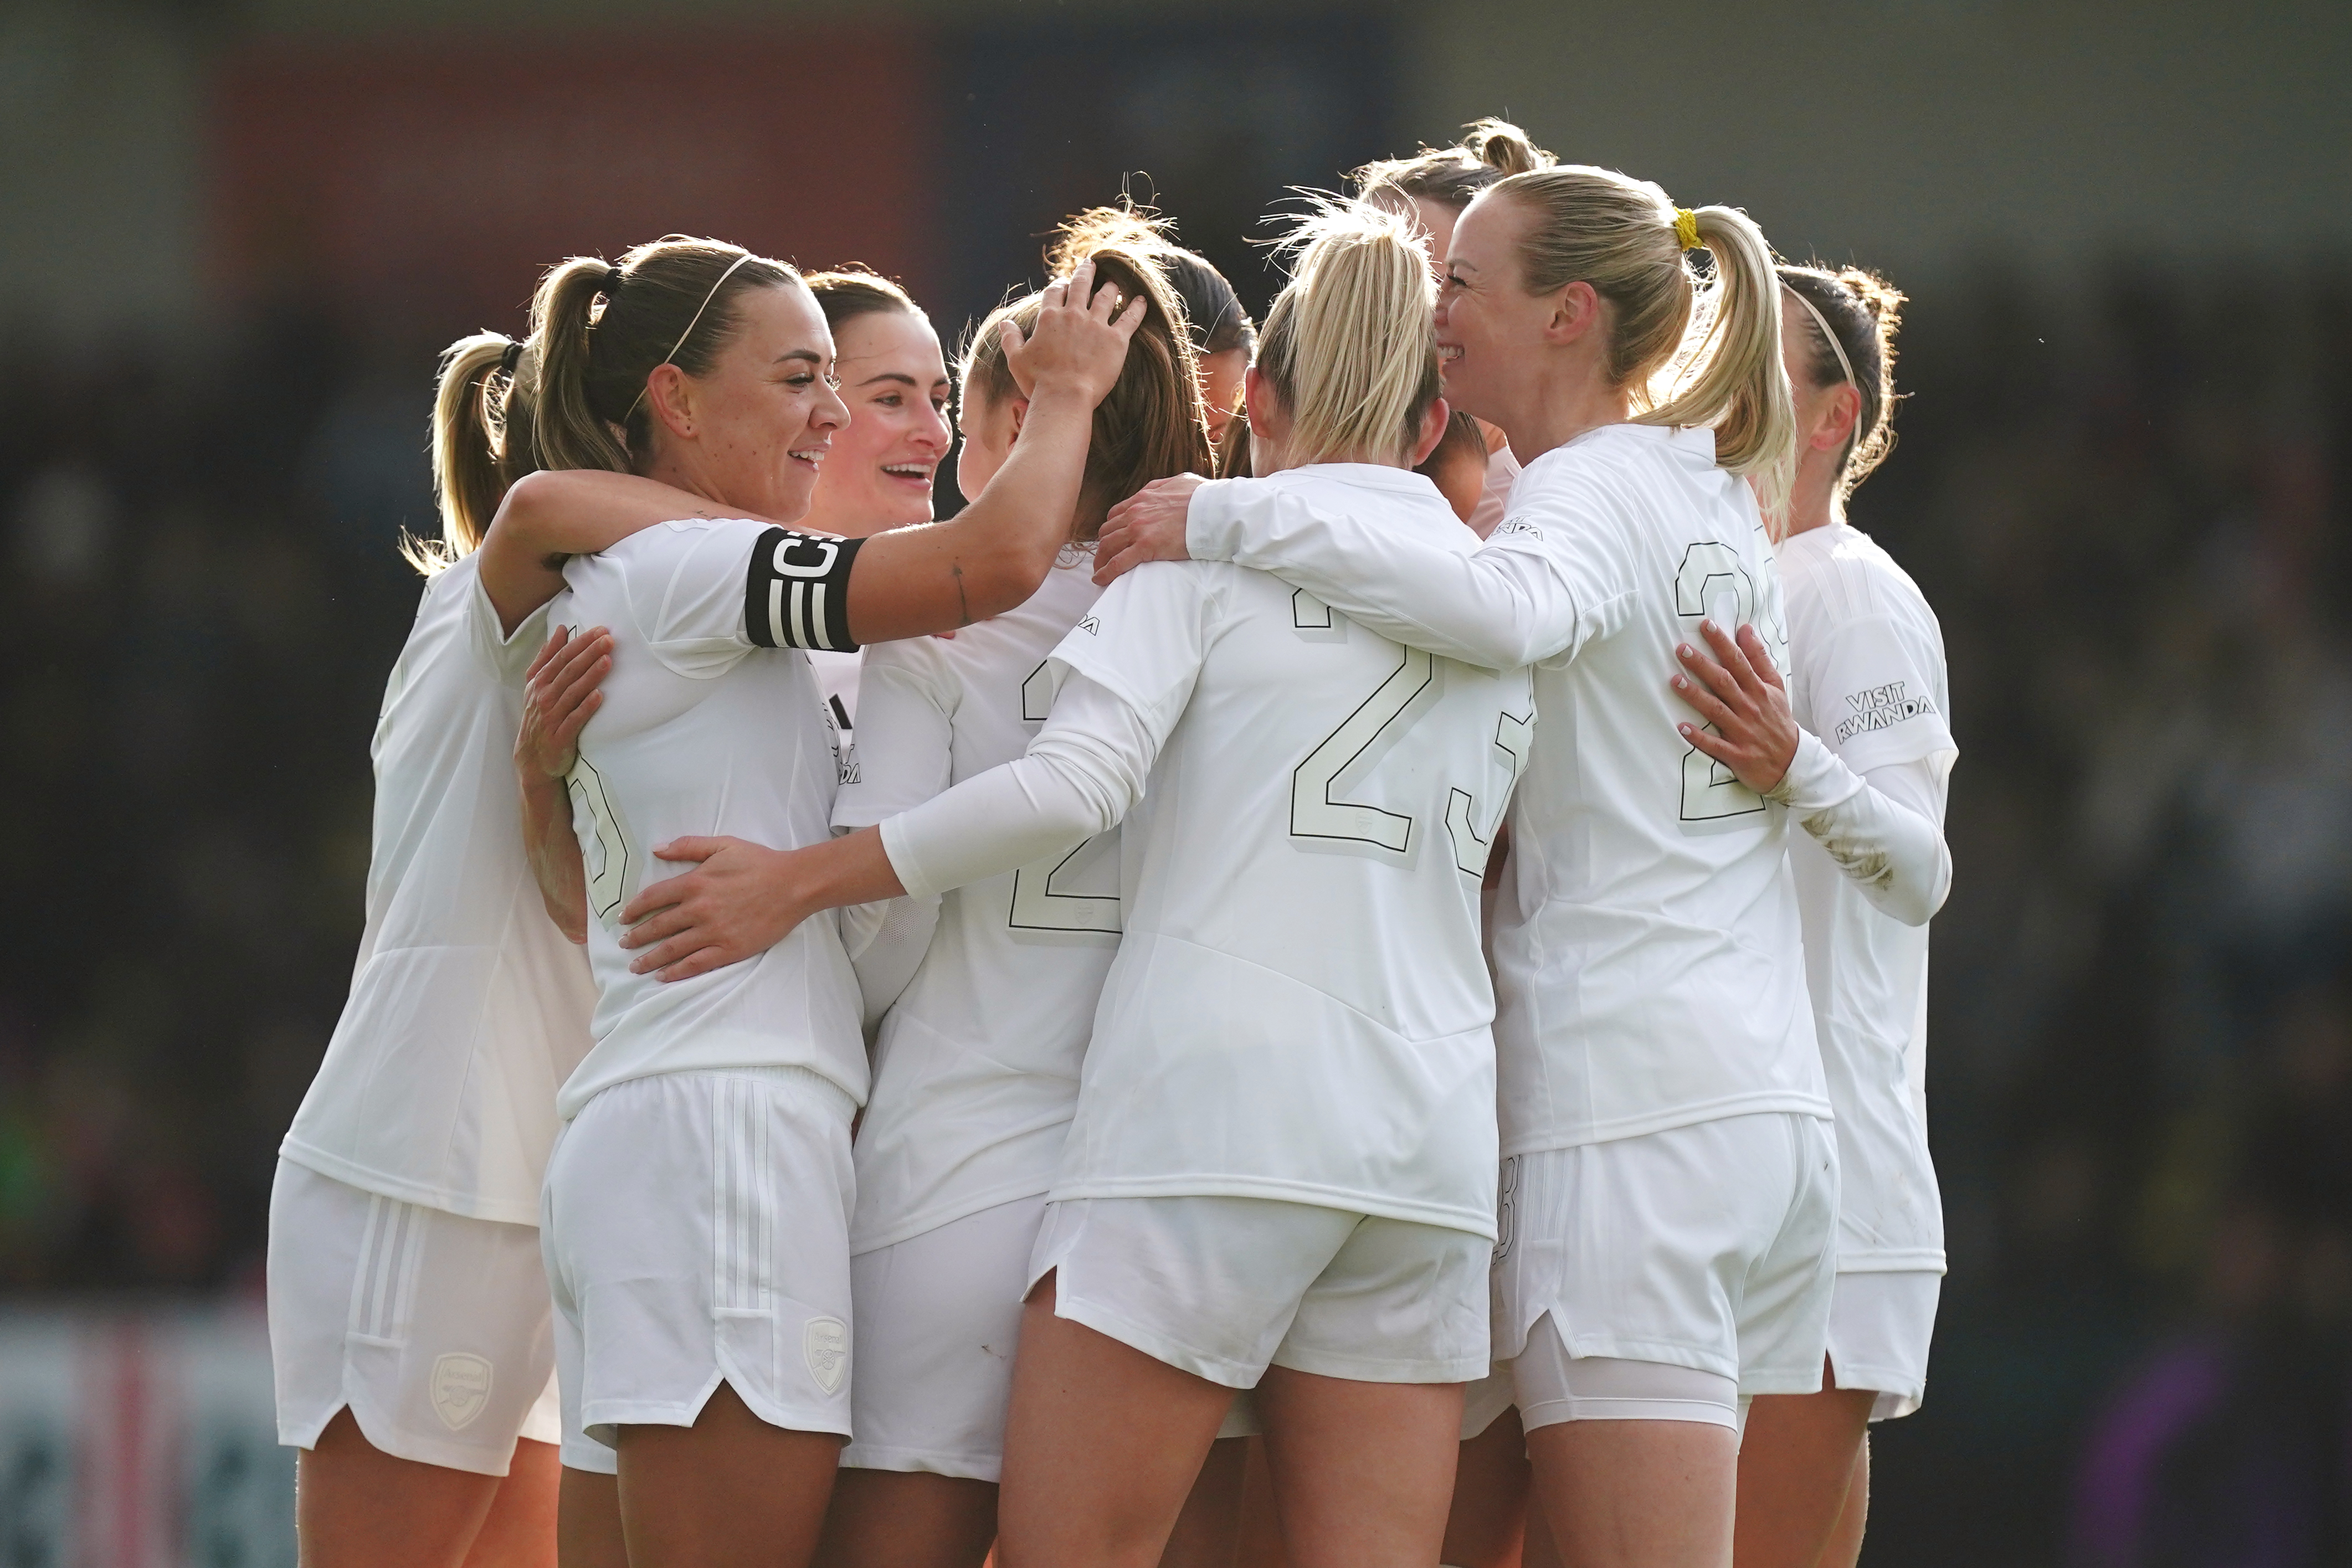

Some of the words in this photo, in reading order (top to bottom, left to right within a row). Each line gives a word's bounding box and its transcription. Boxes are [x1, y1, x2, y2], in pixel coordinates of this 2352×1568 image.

[1846, 681, 1904, 712] VISIT
[1835, 696, 1937, 745] RWANDA
[814, 1332, 842, 1344] Arsenal
